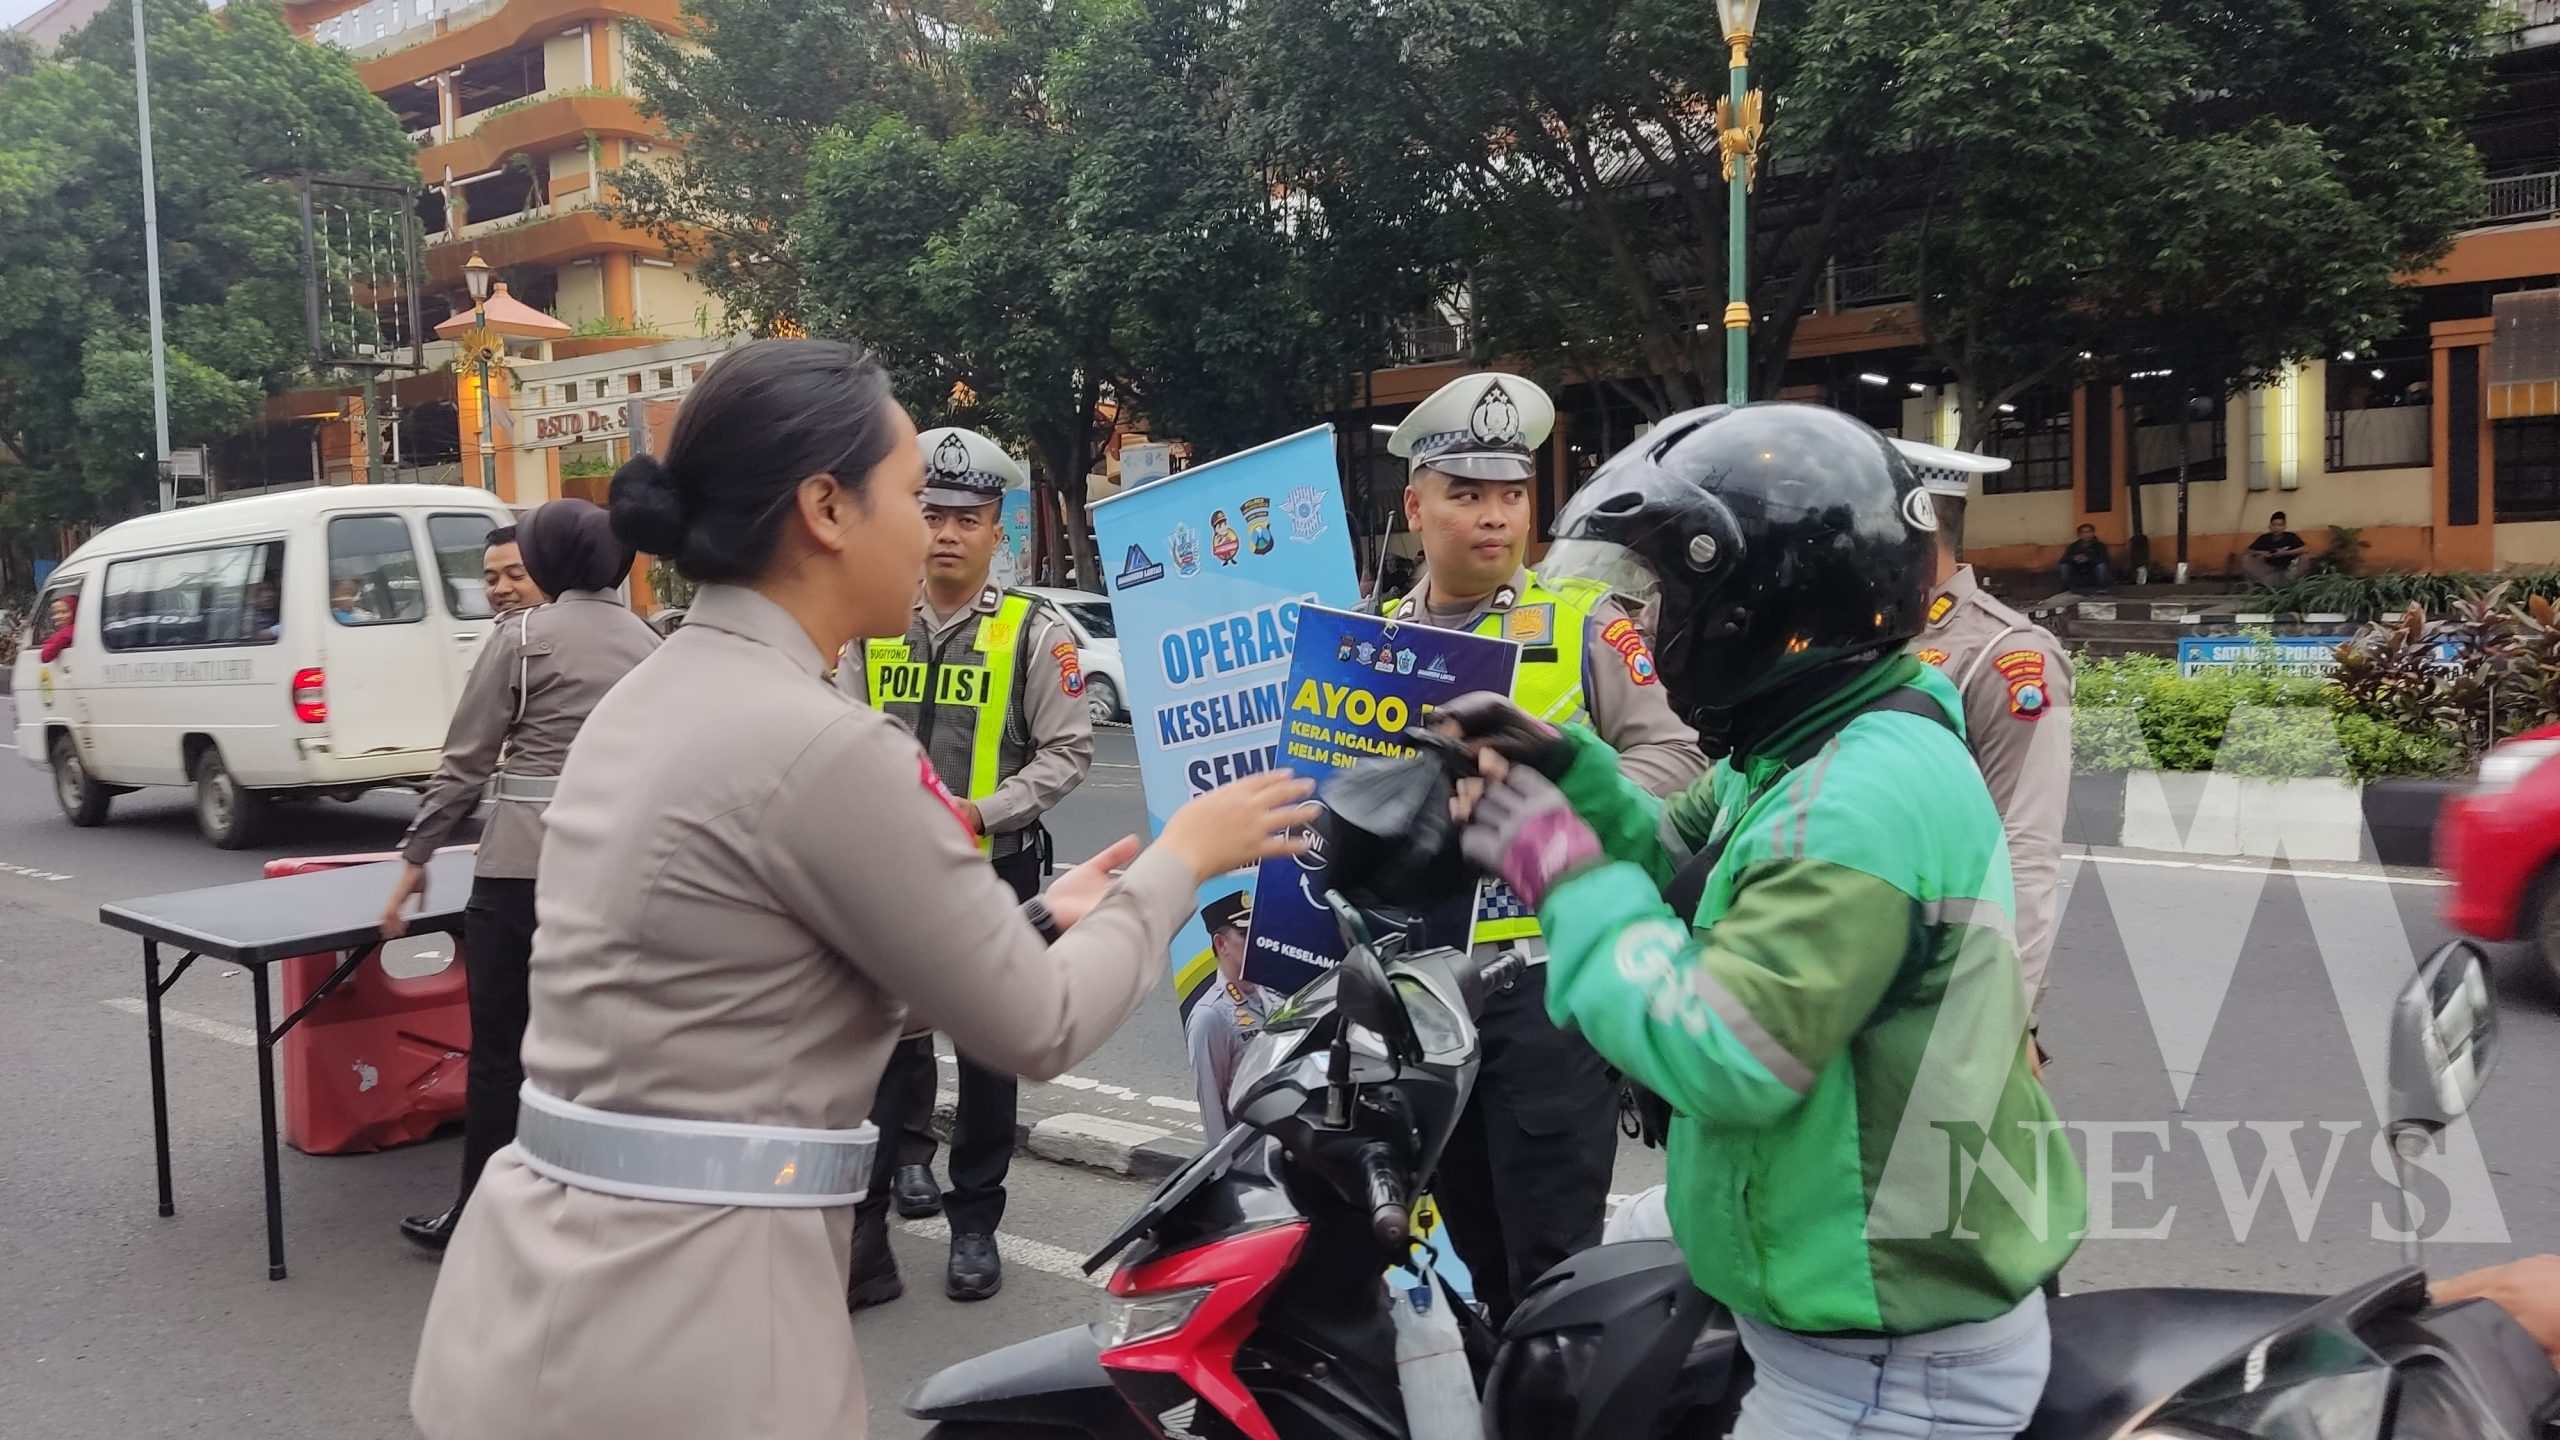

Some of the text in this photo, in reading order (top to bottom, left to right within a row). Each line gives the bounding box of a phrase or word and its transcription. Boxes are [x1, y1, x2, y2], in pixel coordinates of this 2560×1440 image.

[1162, 598, 1314, 684] OPERAS
[1291, 677, 1409, 733] AYOO
[1288, 741, 1328, 765] HELM
[1291, 720, 1331, 743] KERA
[1334, 729, 1401, 760] NGALAM
[1302, 829, 1325, 852] SNI
[1256, 936, 1280, 952] OPS
